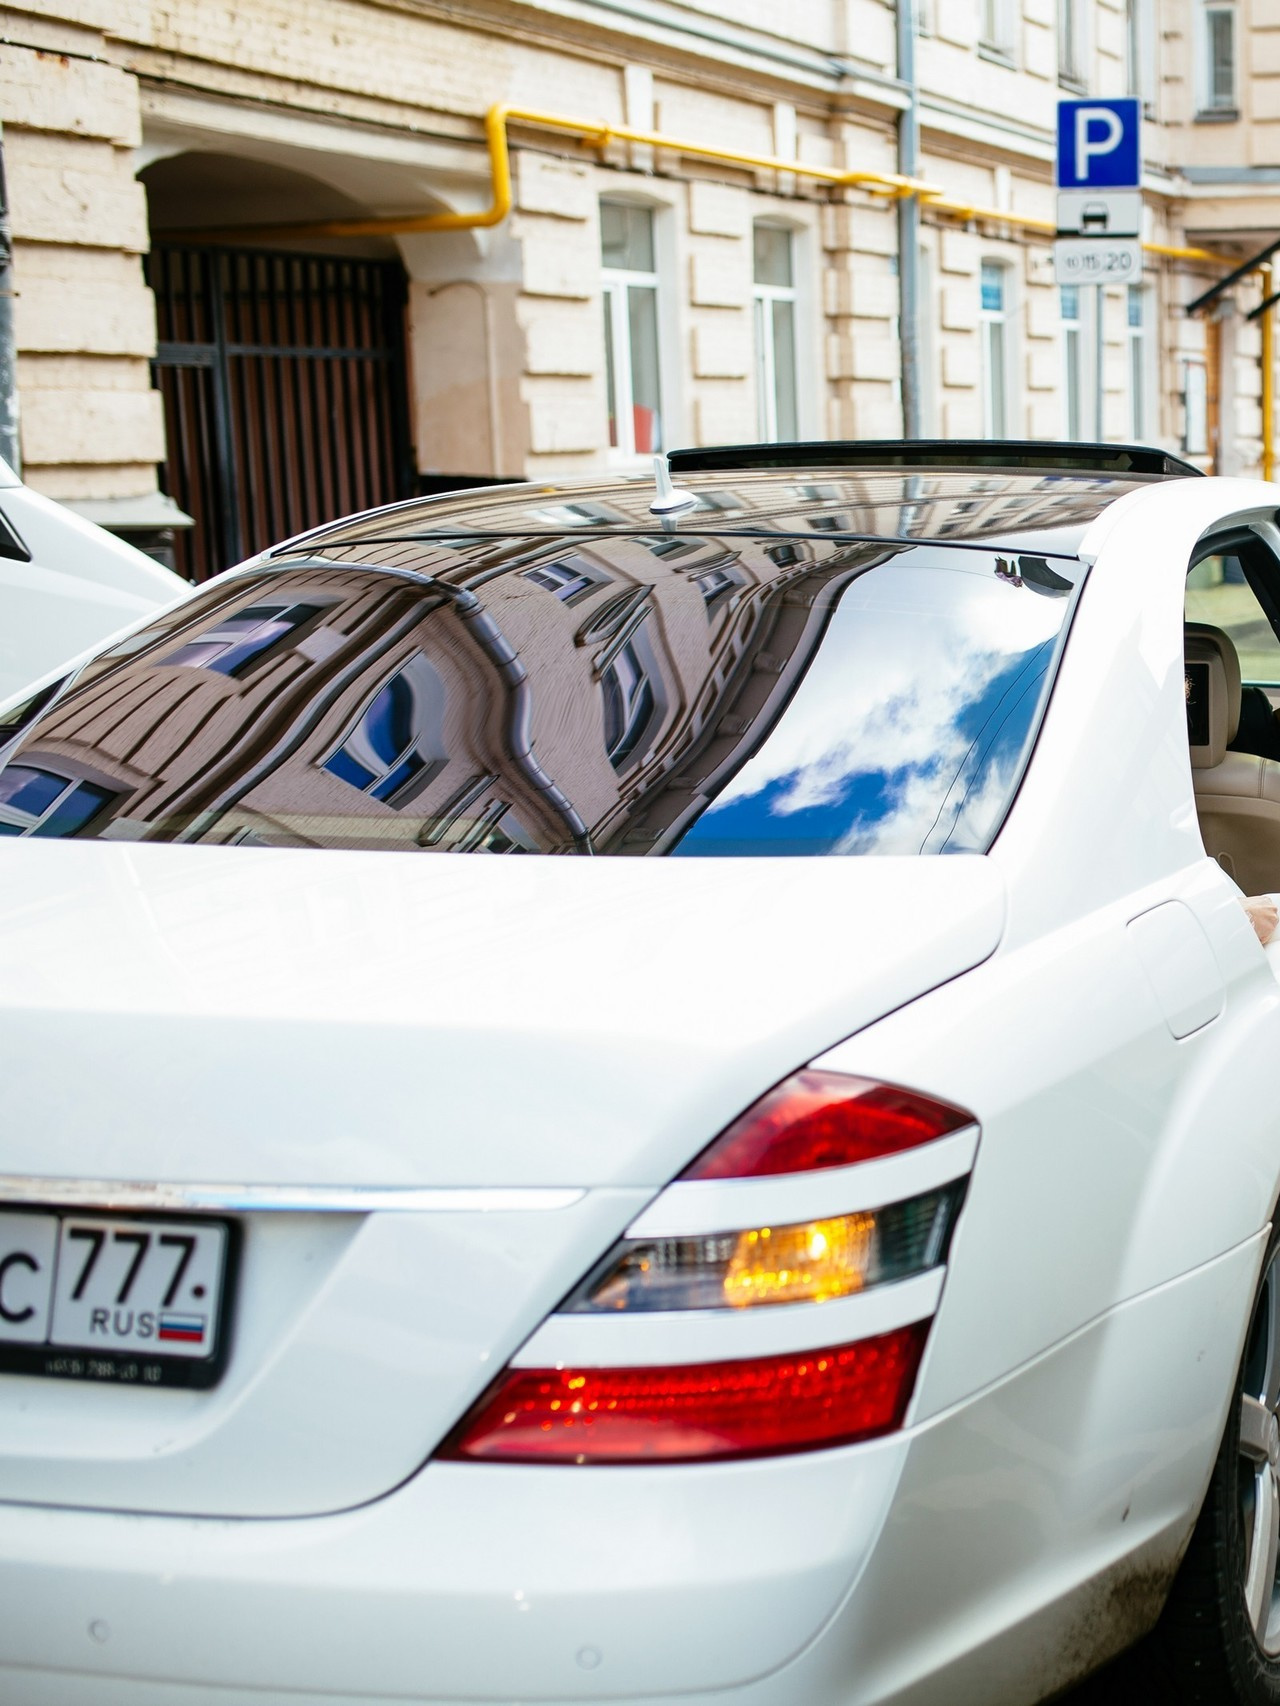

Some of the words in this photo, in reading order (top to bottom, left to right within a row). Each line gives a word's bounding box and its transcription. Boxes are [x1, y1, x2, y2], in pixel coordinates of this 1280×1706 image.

[1075, 107, 1123, 180] P
[1105, 252, 1132, 271] 20
[69, 1227, 197, 1308] 777
[90, 1308, 156, 1338] RUS
